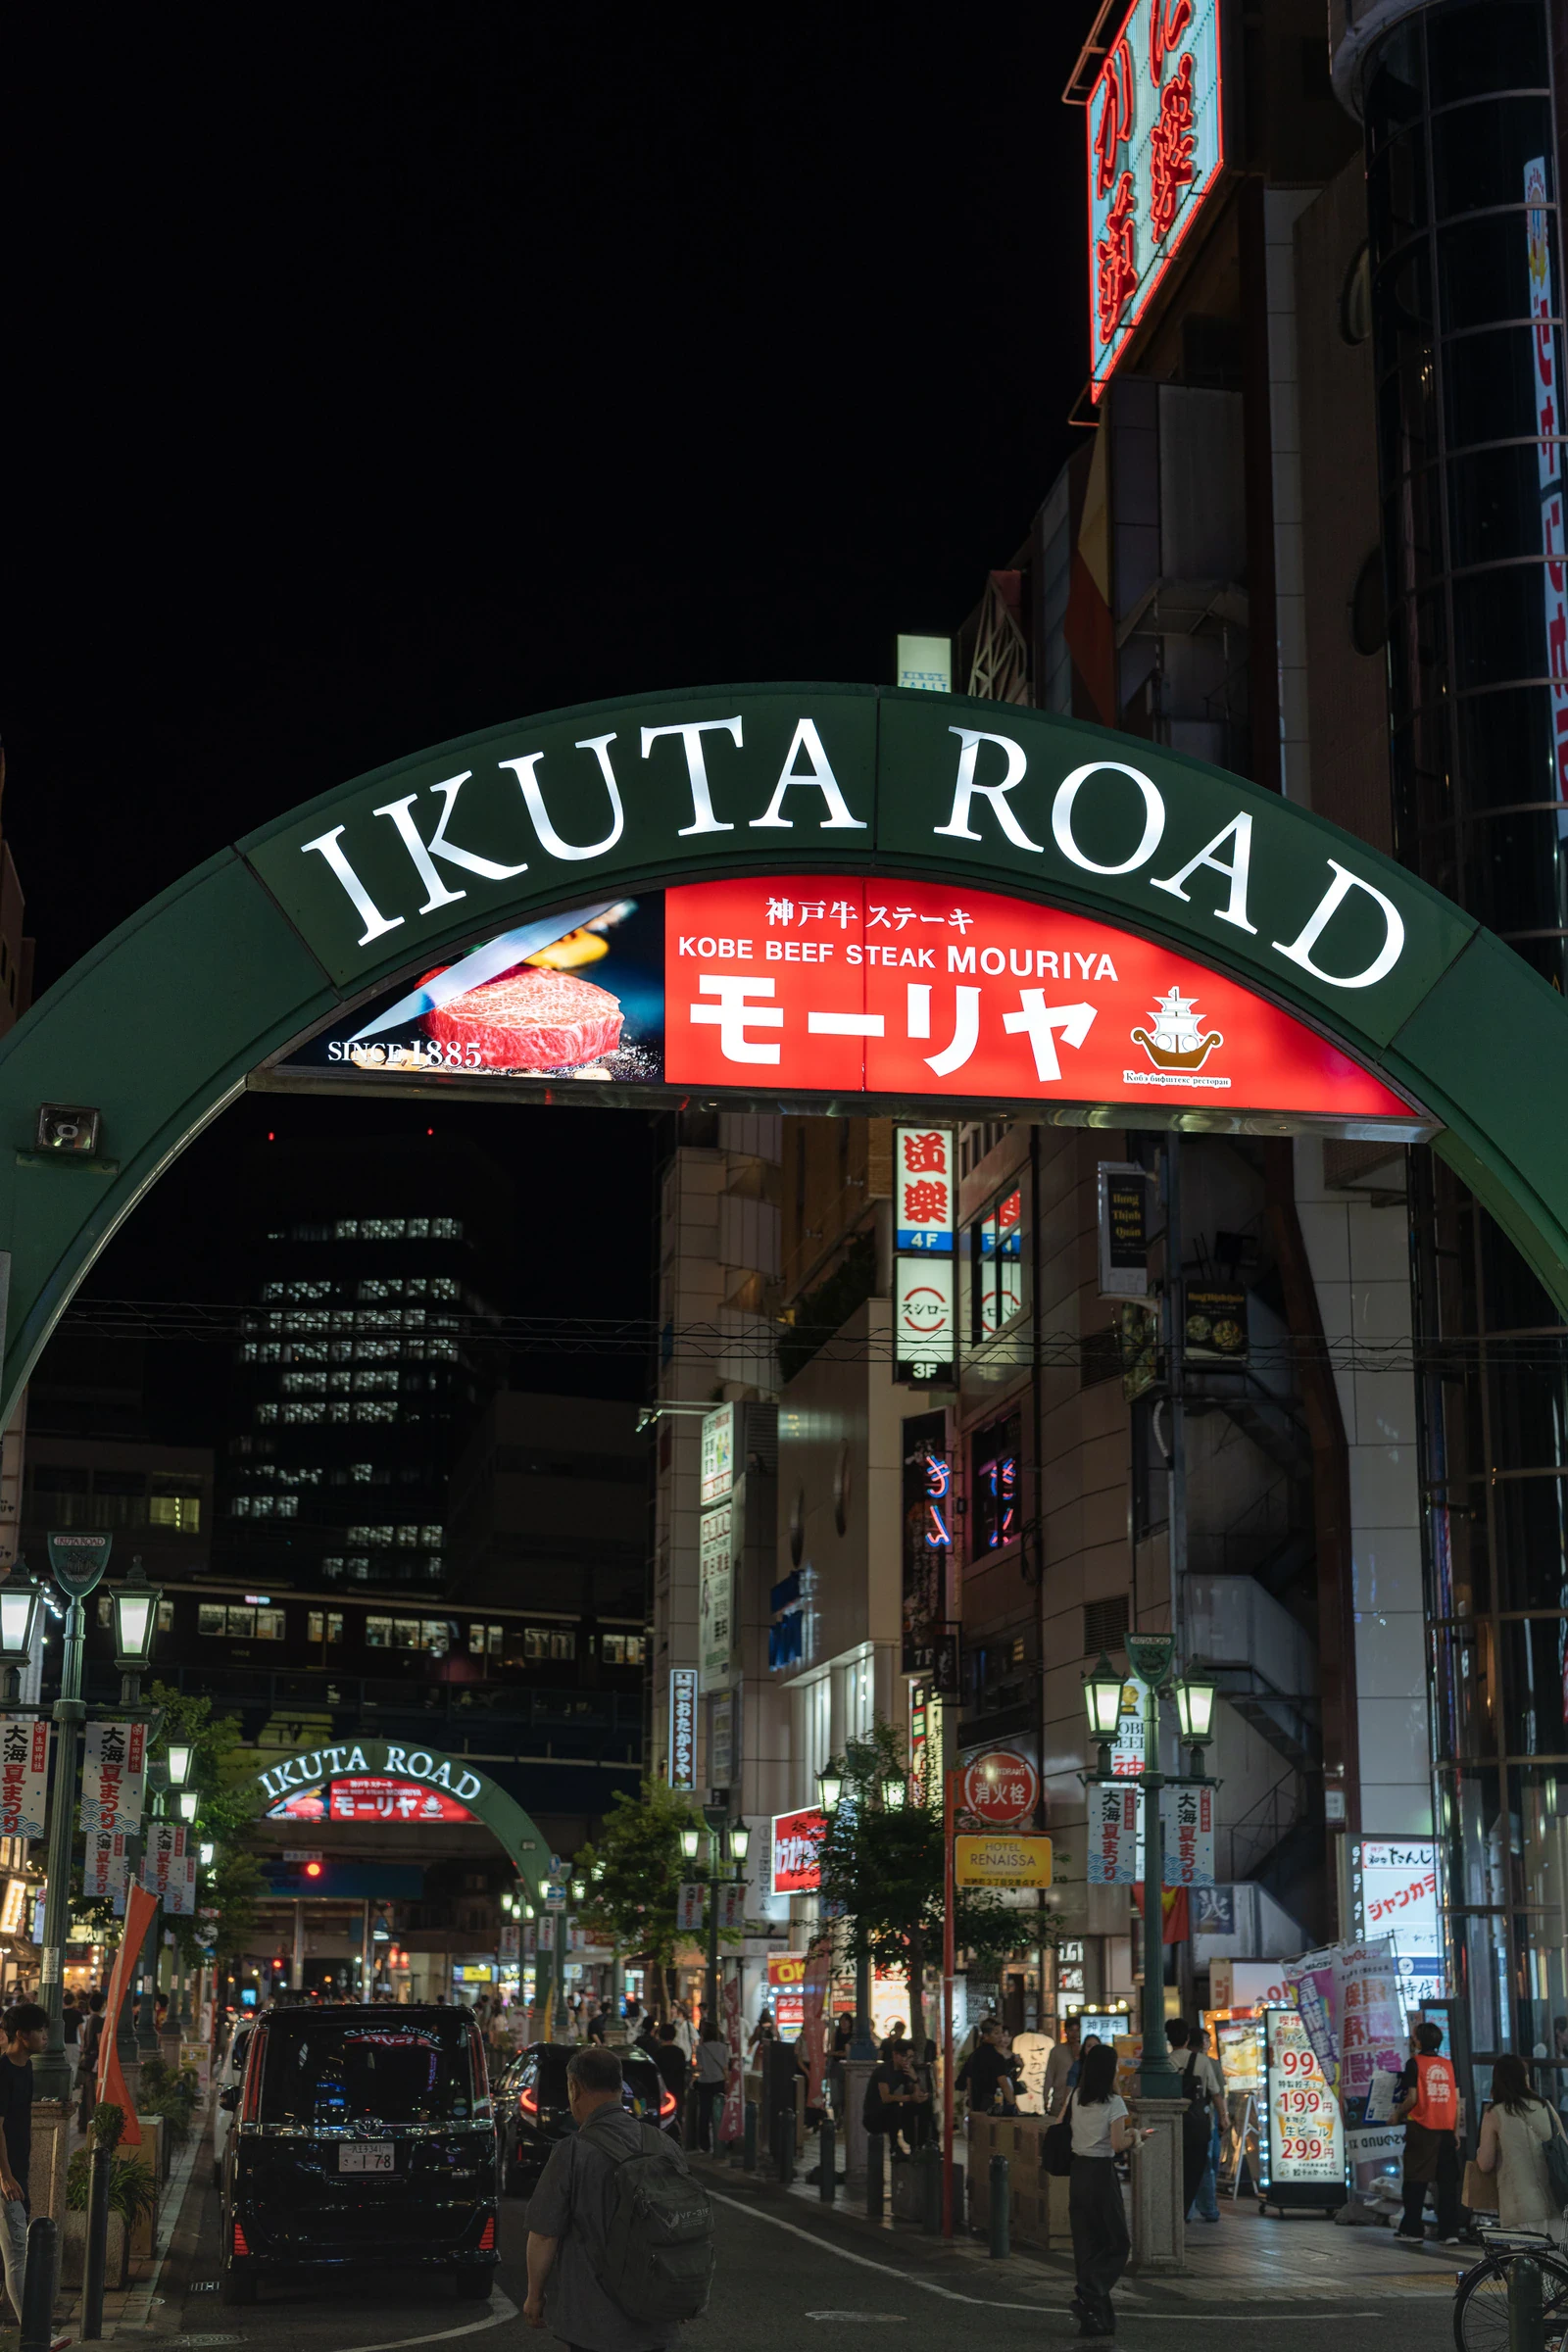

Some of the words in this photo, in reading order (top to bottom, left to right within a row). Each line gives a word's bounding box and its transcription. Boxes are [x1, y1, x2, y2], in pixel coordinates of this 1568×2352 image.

[301, 715, 867, 946] IKUTA
[934, 726, 1405, 988] ROAD
[765, 898, 858, 929] 神戸牛
[868, 906, 974, 935] ステーキ
[679, 937, 753, 958] KOBE
[765, 941, 834, 963] BEEF
[846, 945, 935, 968] STEAK
[948, 946, 1118, 981] MOURIYA
[690, 974, 1098, 1082] モーリヤ
[328, 1041, 403, 1062] SINCE
[412, 1040, 482, 1068] 1885
[1193, 1077, 1229, 1087] ресторан
[911, 1233, 939, 1249] 4F
[901, 1302, 950, 1315] スシロー
[913, 1363, 938, 1378] 3F
[675, 1700, 692, 1779] おたからや
[34, 1736, 43, 1770] 生田神社
[130, 1738, 141, 1771] 生田神社
[2, 1725, 28, 1834] 大海夏まつり
[99, 1727, 125, 1830] 大海夏まつり
[257, 1745, 369, 1799] IKUTA
[383, 1745, 481, 1799] ROAD
[974, 1782, 1027, 1805] 消火栓
[334, 1796, 417, 1818] モーリヤ
[985, 1842, 1021, 1852] HOTEL
[1102, 1790, 1121, 1881] 大海夏まつり
[1178, 1793, 1198, 1883] 大海夏まつり
[157, 1828, 172, 1892] 大海夏まつり
[970, 1854, 1037, 1866] RENAISSA
[1351, 1846, 1361, 1865] 6F
[1353, 1874, 1361, 1892] 5F
[1368, 1874, 1437, 1921] ジャンカラ
[1353, 1901, 1362, 1921] 4F
[1086, 2020, 1123, 2031] 神戸牛
[1283, 2051, 1322, 2076] 99
[1280, 2092, 1333, 2113] 199円
[1286, 2126, 1329, 2136] 生ビール
[1282, 2139, 1335, 2159] 299円
